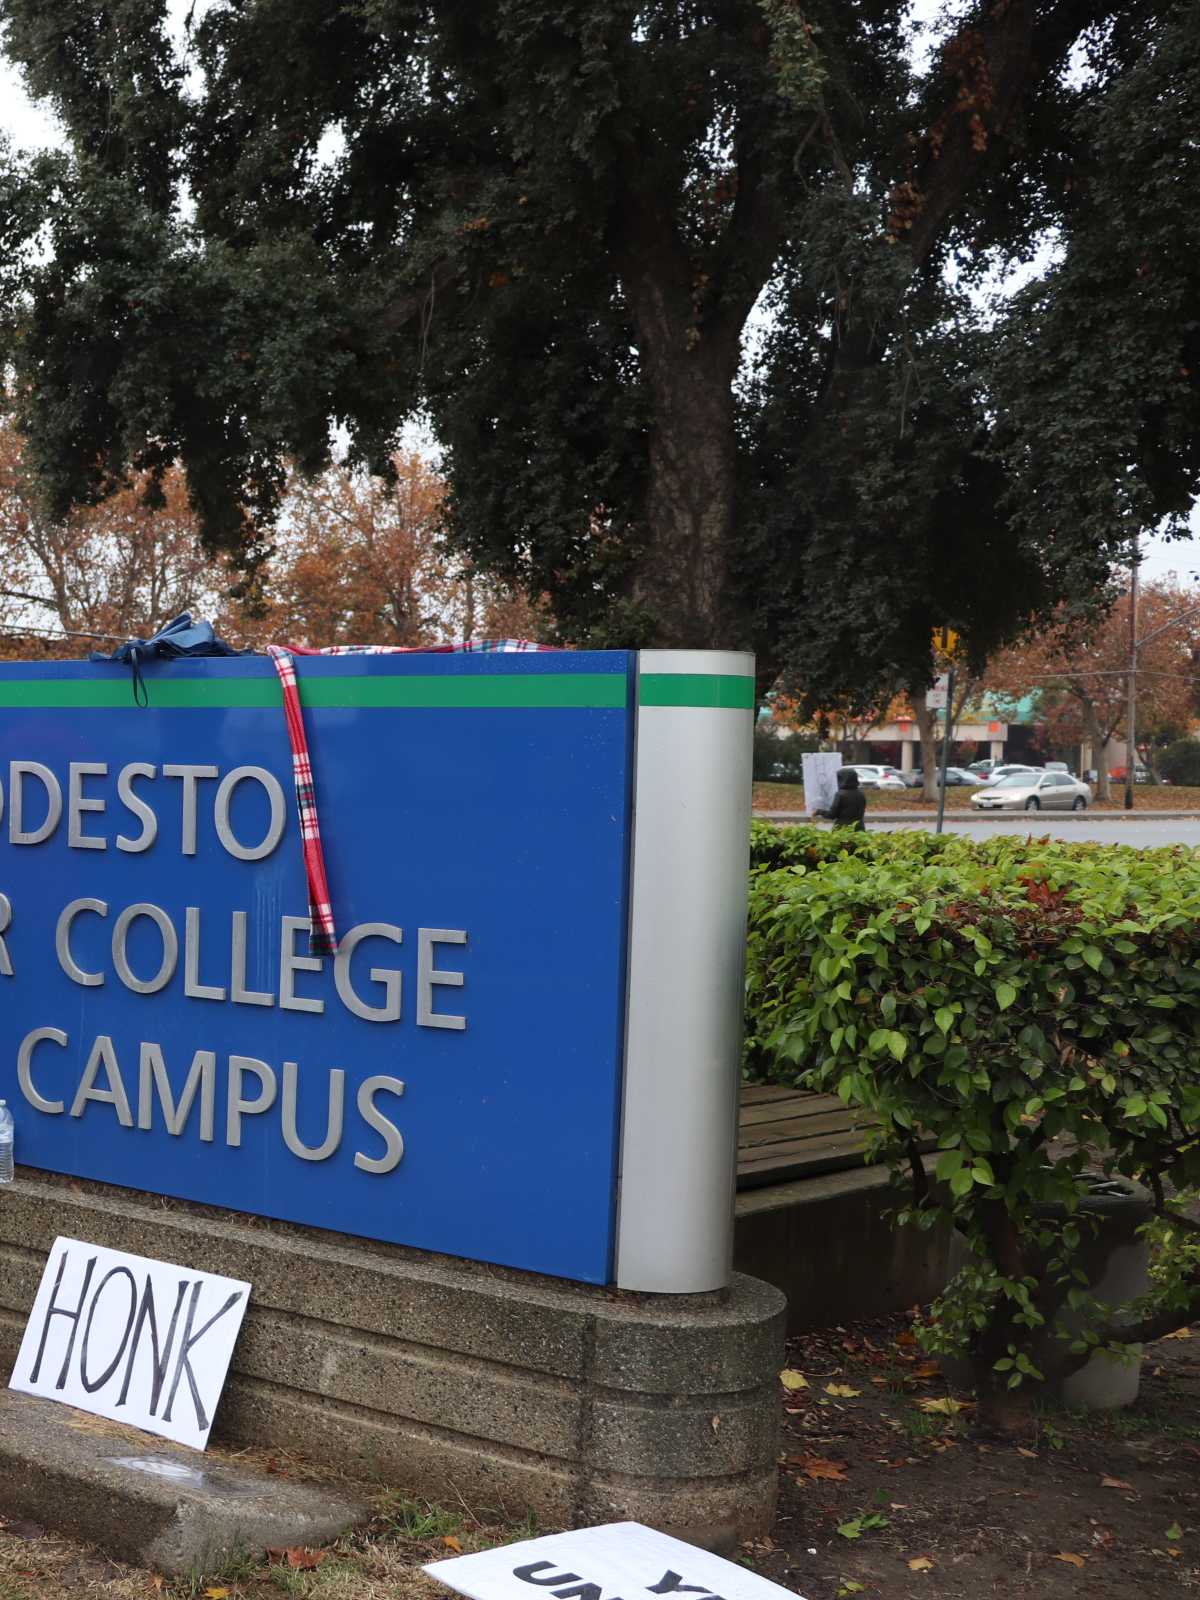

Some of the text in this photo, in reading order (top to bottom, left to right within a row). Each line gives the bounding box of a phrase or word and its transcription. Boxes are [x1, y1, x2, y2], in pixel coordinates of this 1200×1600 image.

[56, 897, 468, 1031] COLLEGE
[16, 1026, 406, 1175] CAMPUS
[29, 1251, 243, 1431] HONK
